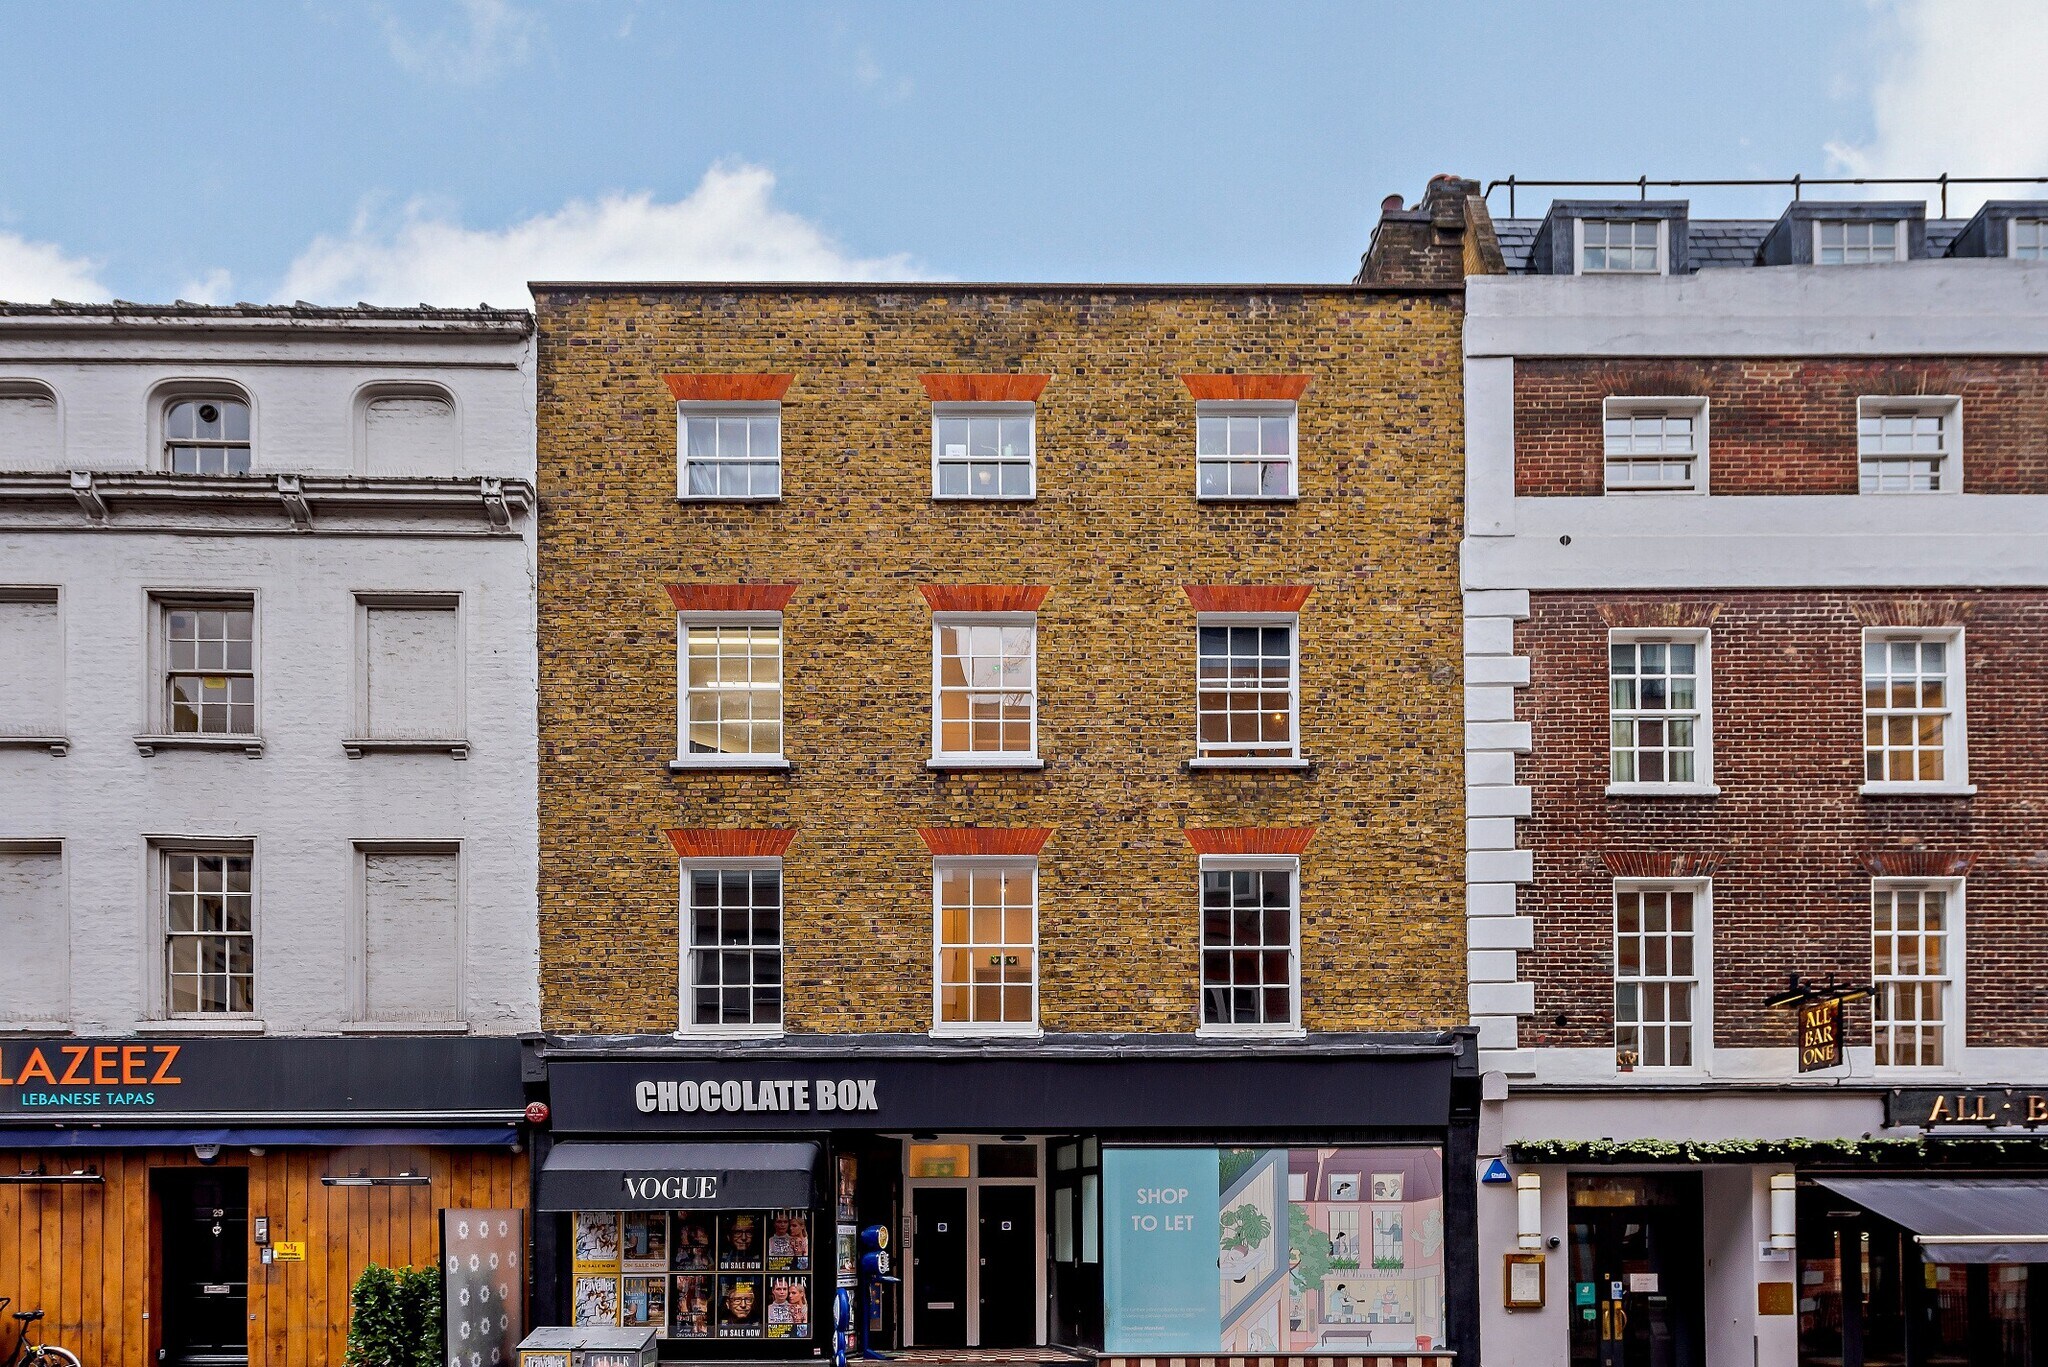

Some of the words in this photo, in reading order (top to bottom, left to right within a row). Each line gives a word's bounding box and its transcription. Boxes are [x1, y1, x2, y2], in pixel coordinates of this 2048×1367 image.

[1806, 1007, 1832, 1028] ALL
[1804, 1025, 1834, 1047] BAR
[1802, 1044, 1835, 1065] ONE
[0, 1045, 182, 1085] LAZEEZ
[22, 1093, 101, 1106] LEBANESE
[106, 1092, 155, 1105] TAPAS
[635, 1080, 810, 1112] CHOCOLATE
[815, 1079, 879, 1111] BOX
[1928, 1095, 1996, 1121] ALL
[623, 1176, 718, 1200] VOGUE
[1137, 1187, 1189, 1204] SHOP
[212, 1208, 224, 1217] 29
[1131, 1214, 1158, 1231] TO
[1165, 1214, 1194, 1231] LET
[720, 1261, 729, 1270] ON
[730, 1261, 745, 1270] SALE
[746, 1261, 761, 1270] NOW
[580, 1277, 616, 1292] Traveller
[719, 1329, 728, 1337] ON
[729, 1329, 744, 1337] SALE
[745, 1329, 760, 1337] NOW
